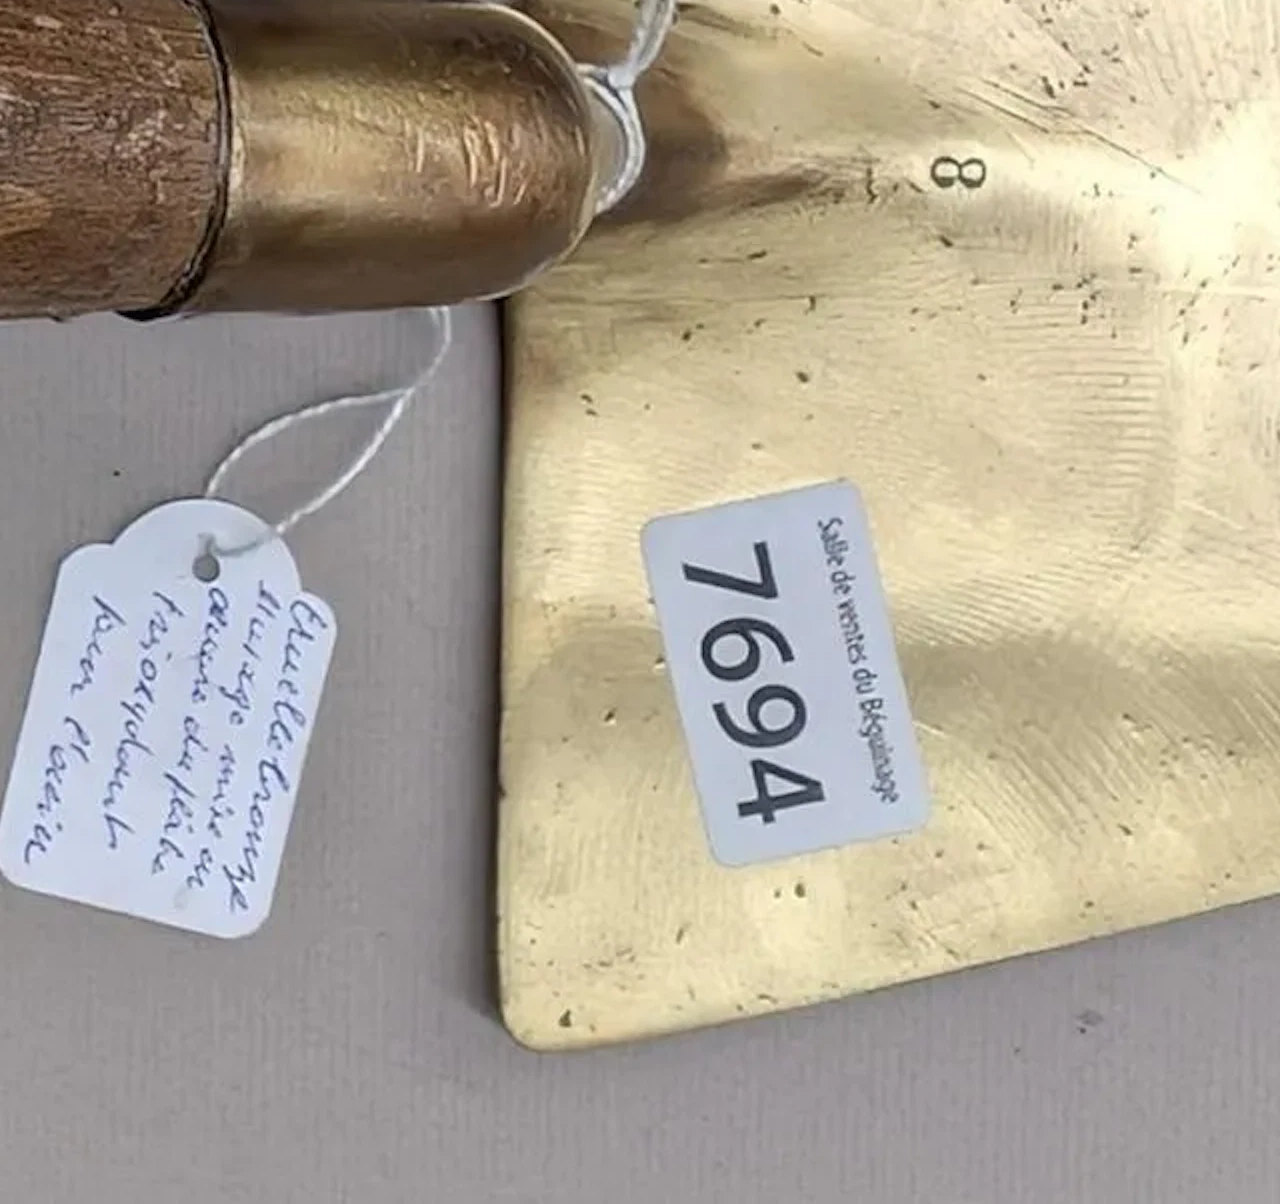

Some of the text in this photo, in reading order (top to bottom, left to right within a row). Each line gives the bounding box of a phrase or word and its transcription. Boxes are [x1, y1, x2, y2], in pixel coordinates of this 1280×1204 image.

[930, 156, 987, 189] 8
[681, 540, 826, 826] 7694
[817, 517, 900, 804] Salle de ventes du Béguinage
